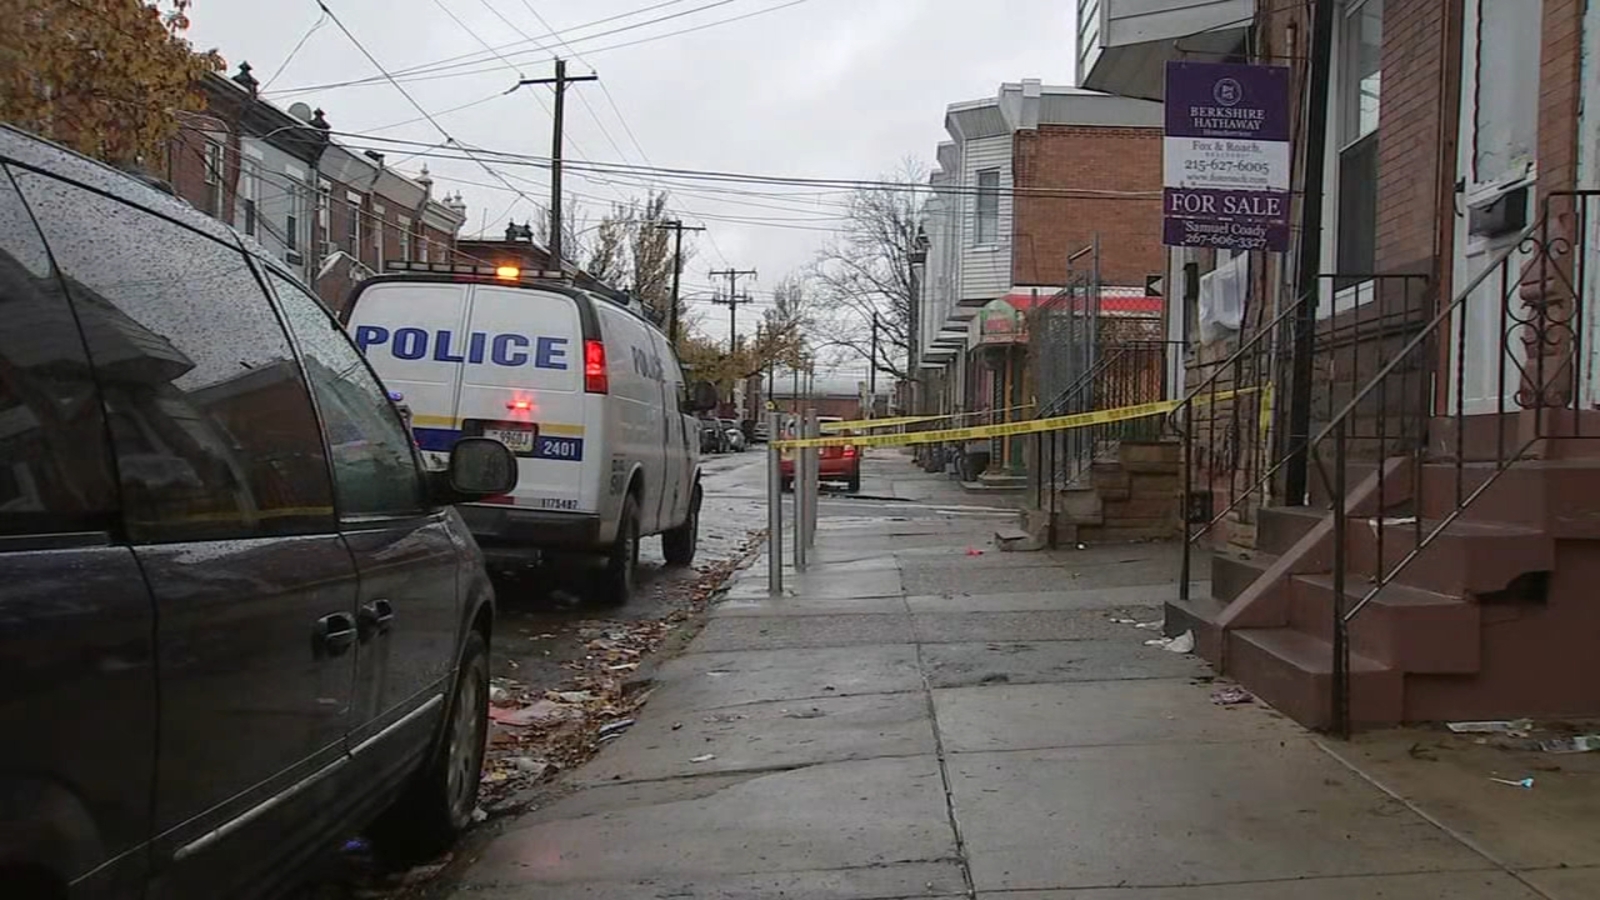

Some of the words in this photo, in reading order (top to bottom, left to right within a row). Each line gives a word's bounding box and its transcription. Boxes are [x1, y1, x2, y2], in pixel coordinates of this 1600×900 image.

[1190, 106, 1265, 119] BERKSHIRE
[1194, 118, 1261, 130] HATHAWAY
[1192, 140, 1212, 151] Fox
[1214, 142, 1224, 151] &
[1184, 159, 1269, 175] 215-627-6005
[1171, 193, 1216, 213] FOR
[1223, 195, 1281, 216] SALE
[1185, 220, 1229, 234] Samuel
[355, 325, 568, 370] POLICE
[544, 440, 575, 456] 2401
